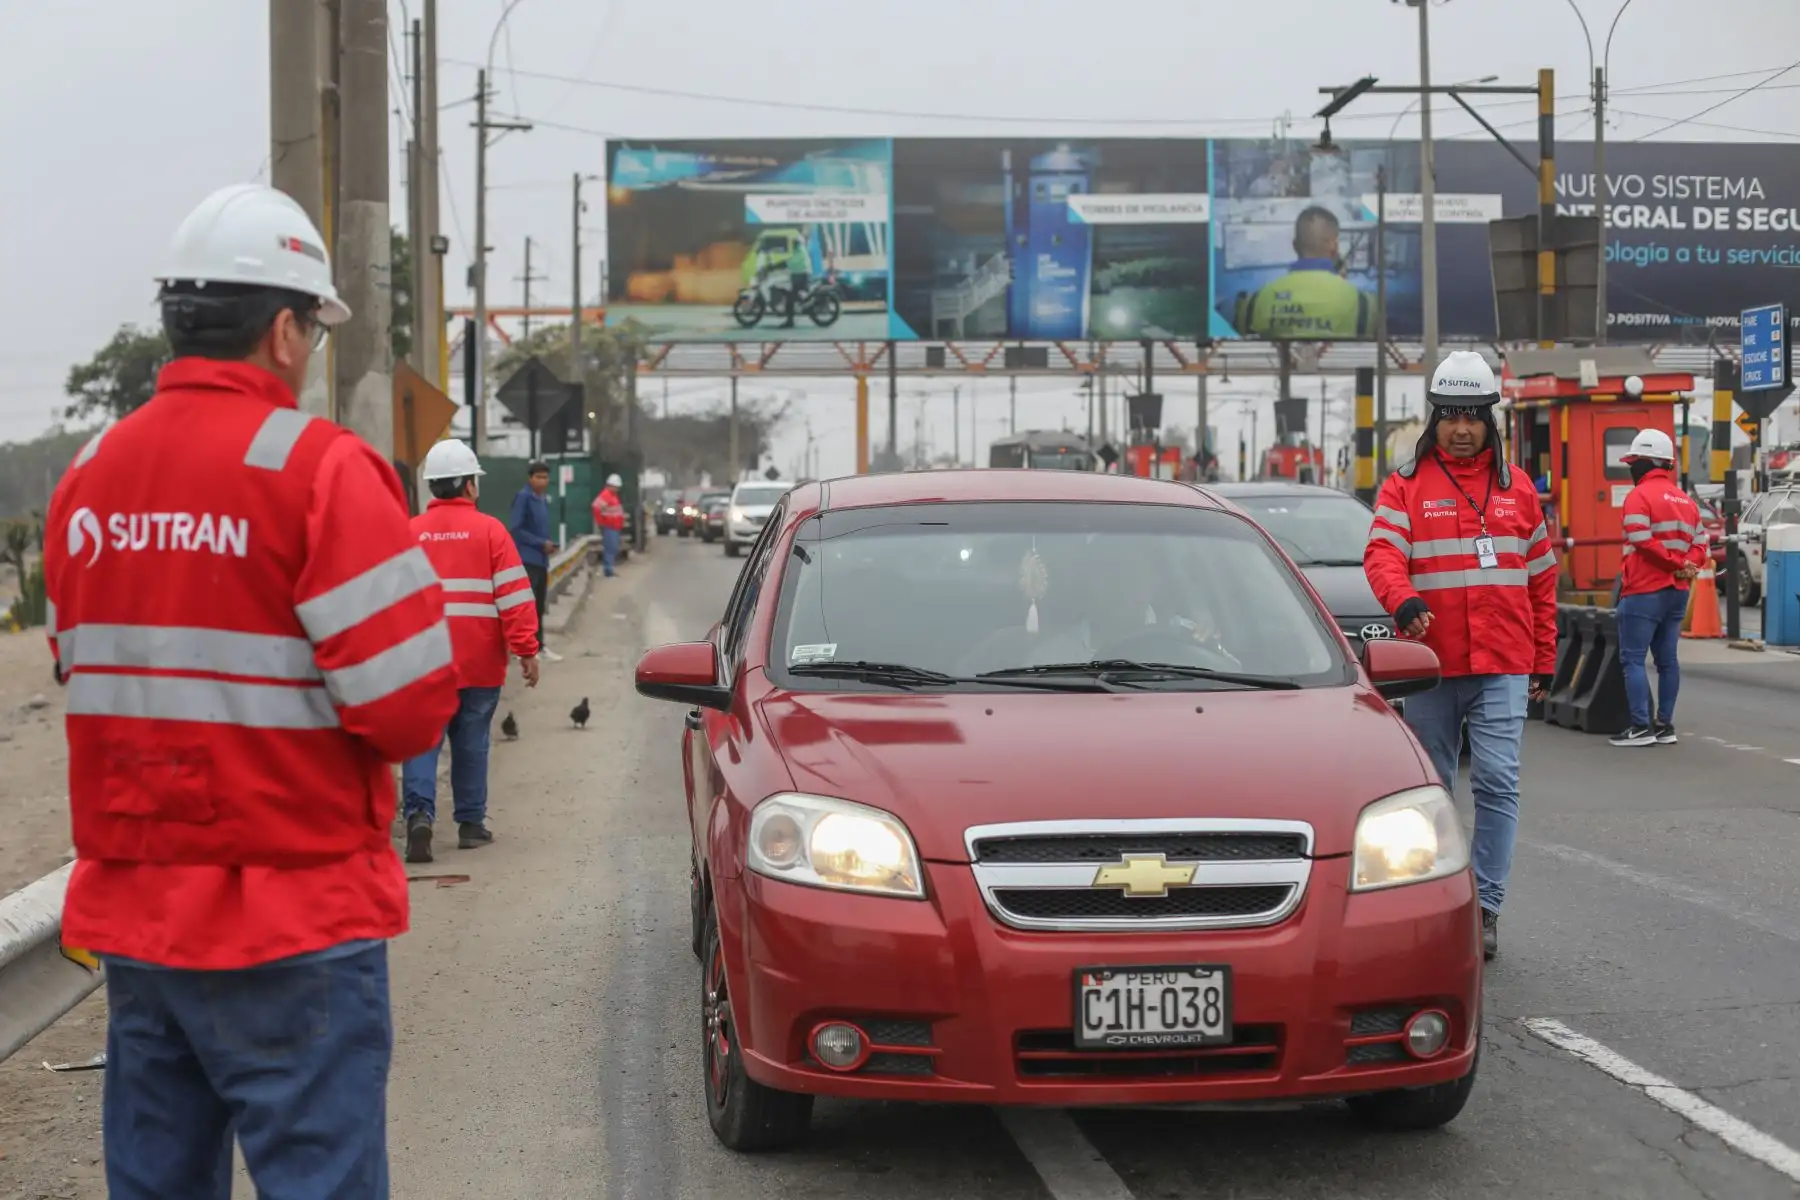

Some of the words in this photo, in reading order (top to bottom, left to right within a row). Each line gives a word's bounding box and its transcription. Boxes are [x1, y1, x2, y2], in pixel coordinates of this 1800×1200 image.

[1652, 174, 1766, 200] SISTEMA
[1554, 203, 1687, 229] NTEGRAL
[1693, 206, 1730, 230] DE
[1604, 239, 1669, 268] ología
[1676, 247, 1690, 263] a
[1696, 244, 1720, 264] tu
[1617, 313, 1671, 327] POSITIVA
[1447, 380, 1481, 389] SUTRAN
[108, 511, 249, 558] SUTRAN
[432, 531, 470, 541] SUTRAN
[1084, 986, 1222, 1031] C1H-038
[1129, 1034, 1203, 1045] CHEVROLET
